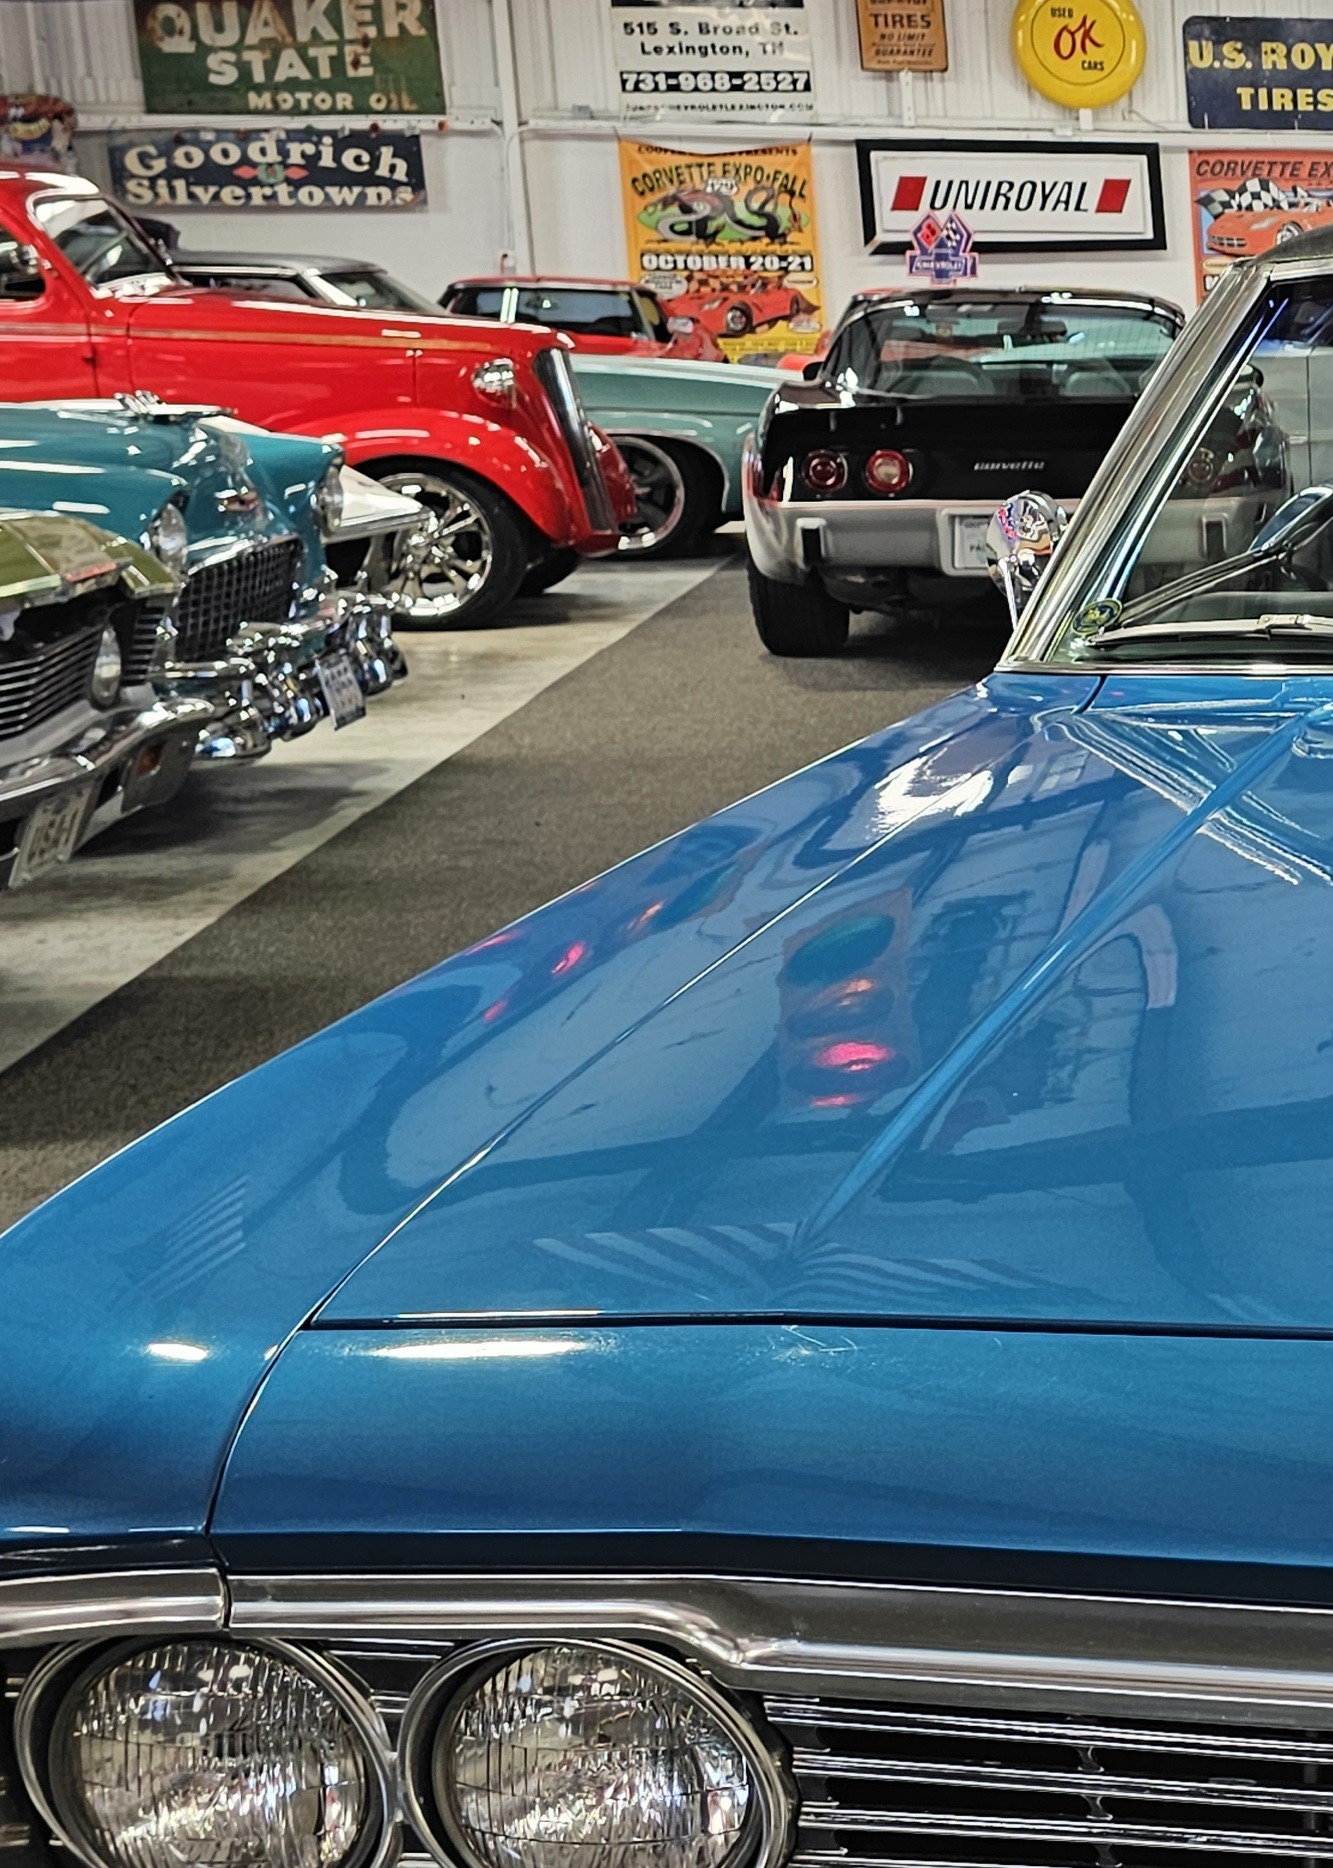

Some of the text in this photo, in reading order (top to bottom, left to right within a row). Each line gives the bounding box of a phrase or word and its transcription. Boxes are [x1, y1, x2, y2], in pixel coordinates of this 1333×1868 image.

[869, 12, 932, 29] TIRES
[1050, 8, 1074, 19] USED
[147, 0, 427, 53] QUAKER
[623, 22, 799, 36] 515 S. Broad St.
[880, 32, 927, 42] NO LIMIT
[1053, 15, 1105, 60] OK
[640, 41, 750, 58] Lexington,
[1188, 40, 1253, 70] U.S.
[206, 45, 375, 86] STATE
[1081, 60, 1105, 72] CARS
[622, 72, 809, 92] 731-968-2527
[248, 91, 418, 111] MOTOR OIL
[123, 136, 410, 183] Goodrich
[1195, 159, 1302, 178] CORVETTE
[631, 161, 716, 197] CORVETTE
[124, 177, 415, 207] Silvertowns
[929, 180, 1090, 212] UNIROYAL
[642, 253, 813, 272] OCTOBER 20-21
